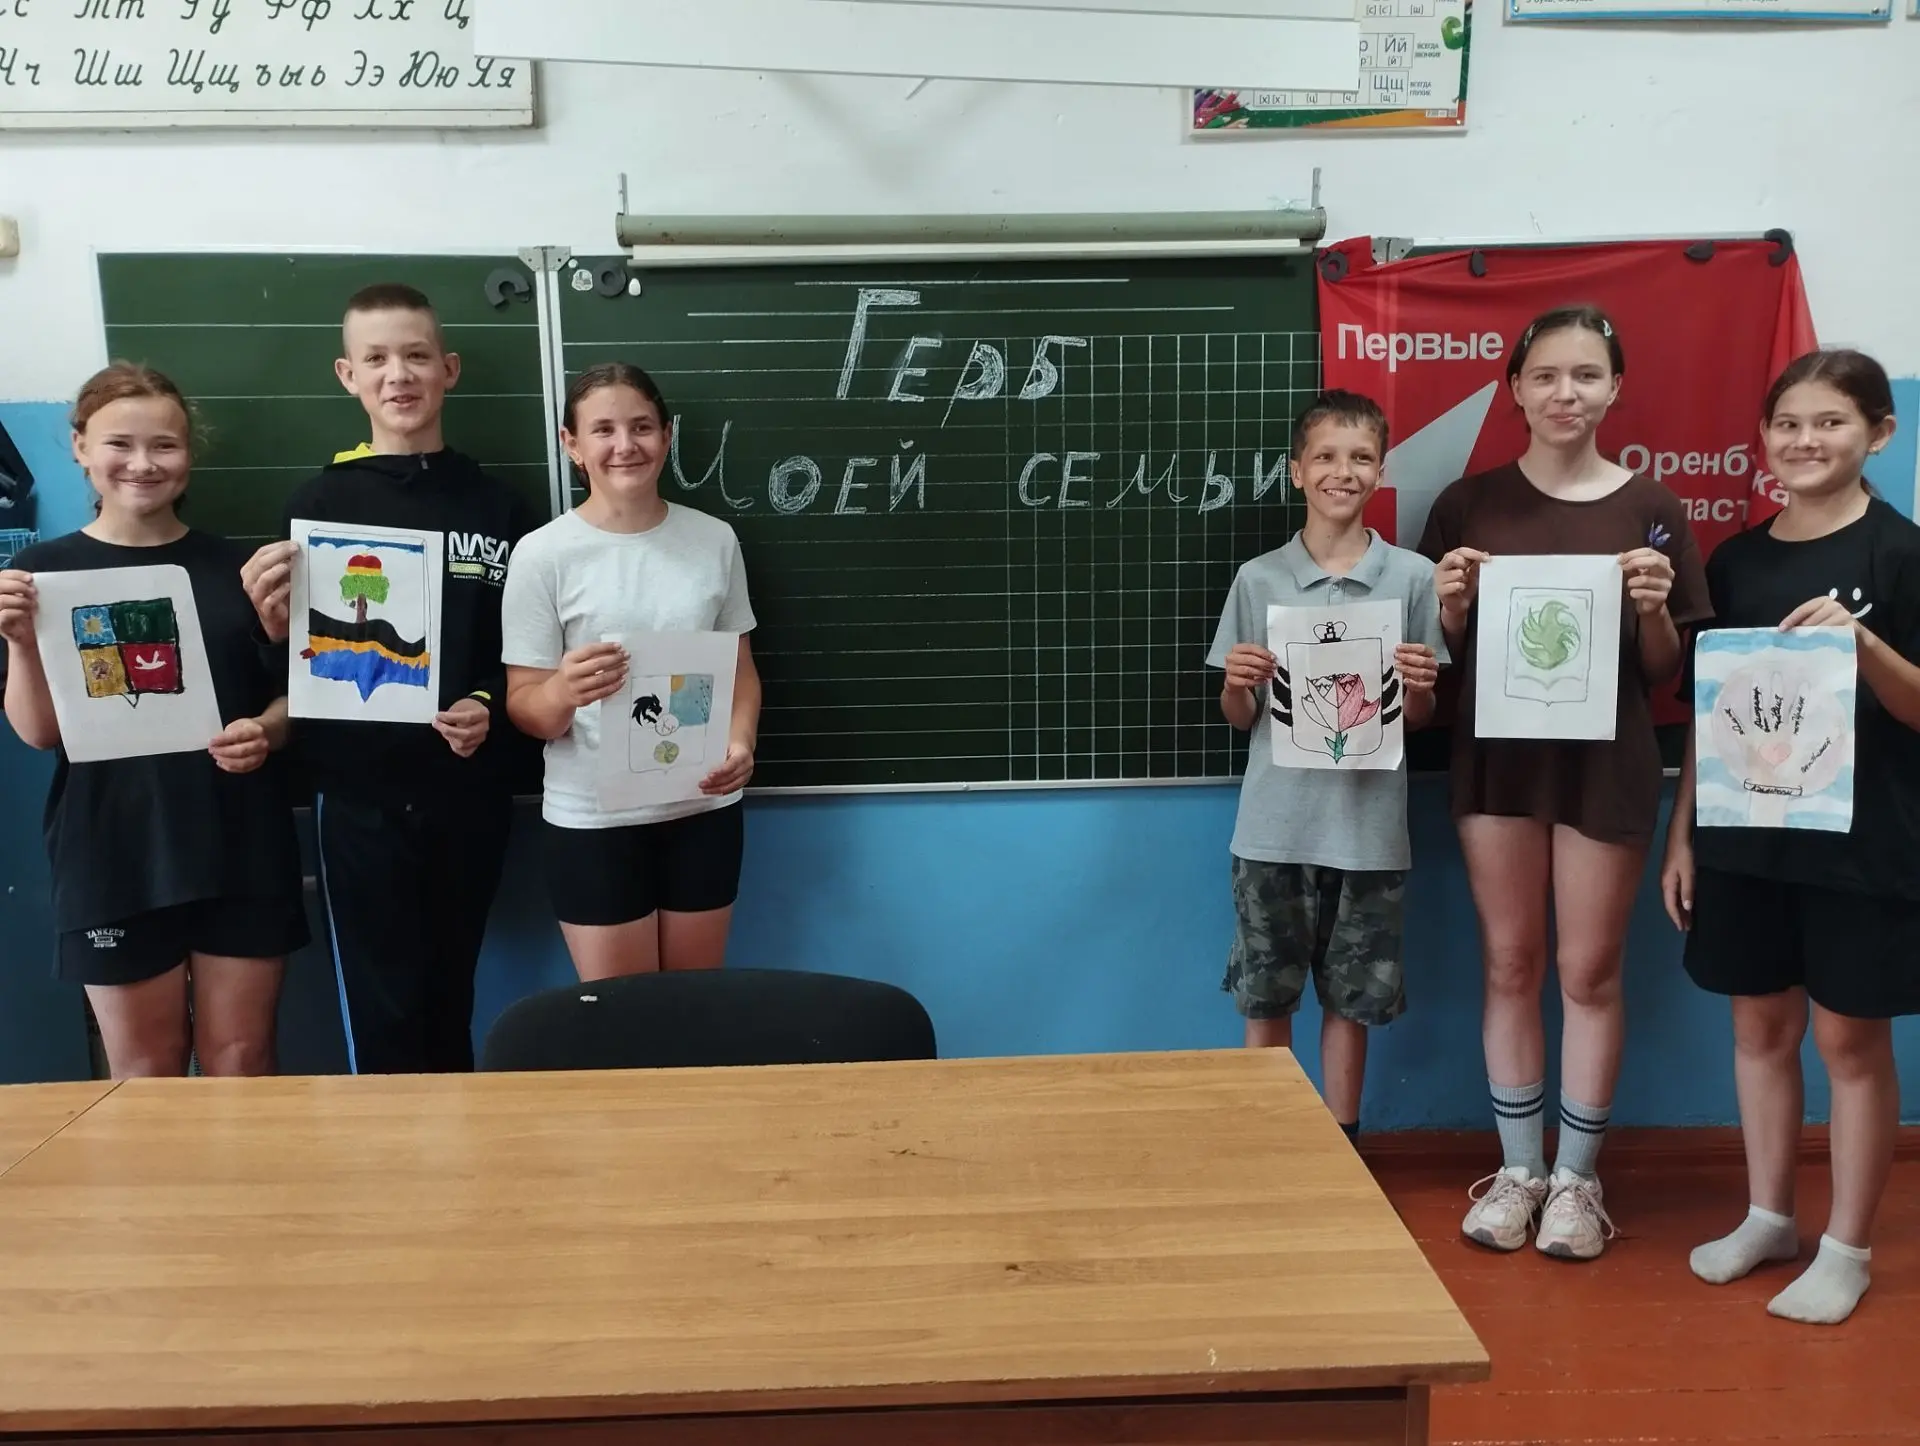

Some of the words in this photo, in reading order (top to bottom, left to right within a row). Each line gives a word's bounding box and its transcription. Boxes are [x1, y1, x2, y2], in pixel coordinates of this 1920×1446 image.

[0, 47, 40, 85] Чч
[74, 48, 142, 85] Шш
[167, 48, 240, 94] Щщ
[345, 50, 384, 86] Ээ
[399, 50, 459, 88] Юю
[468, 57, 515, 88] Яя
[1338, 323, 1503, 371] Первые
[448, 531, 509, 565] NASA
[85, 927, 125, 939] YANKEES
